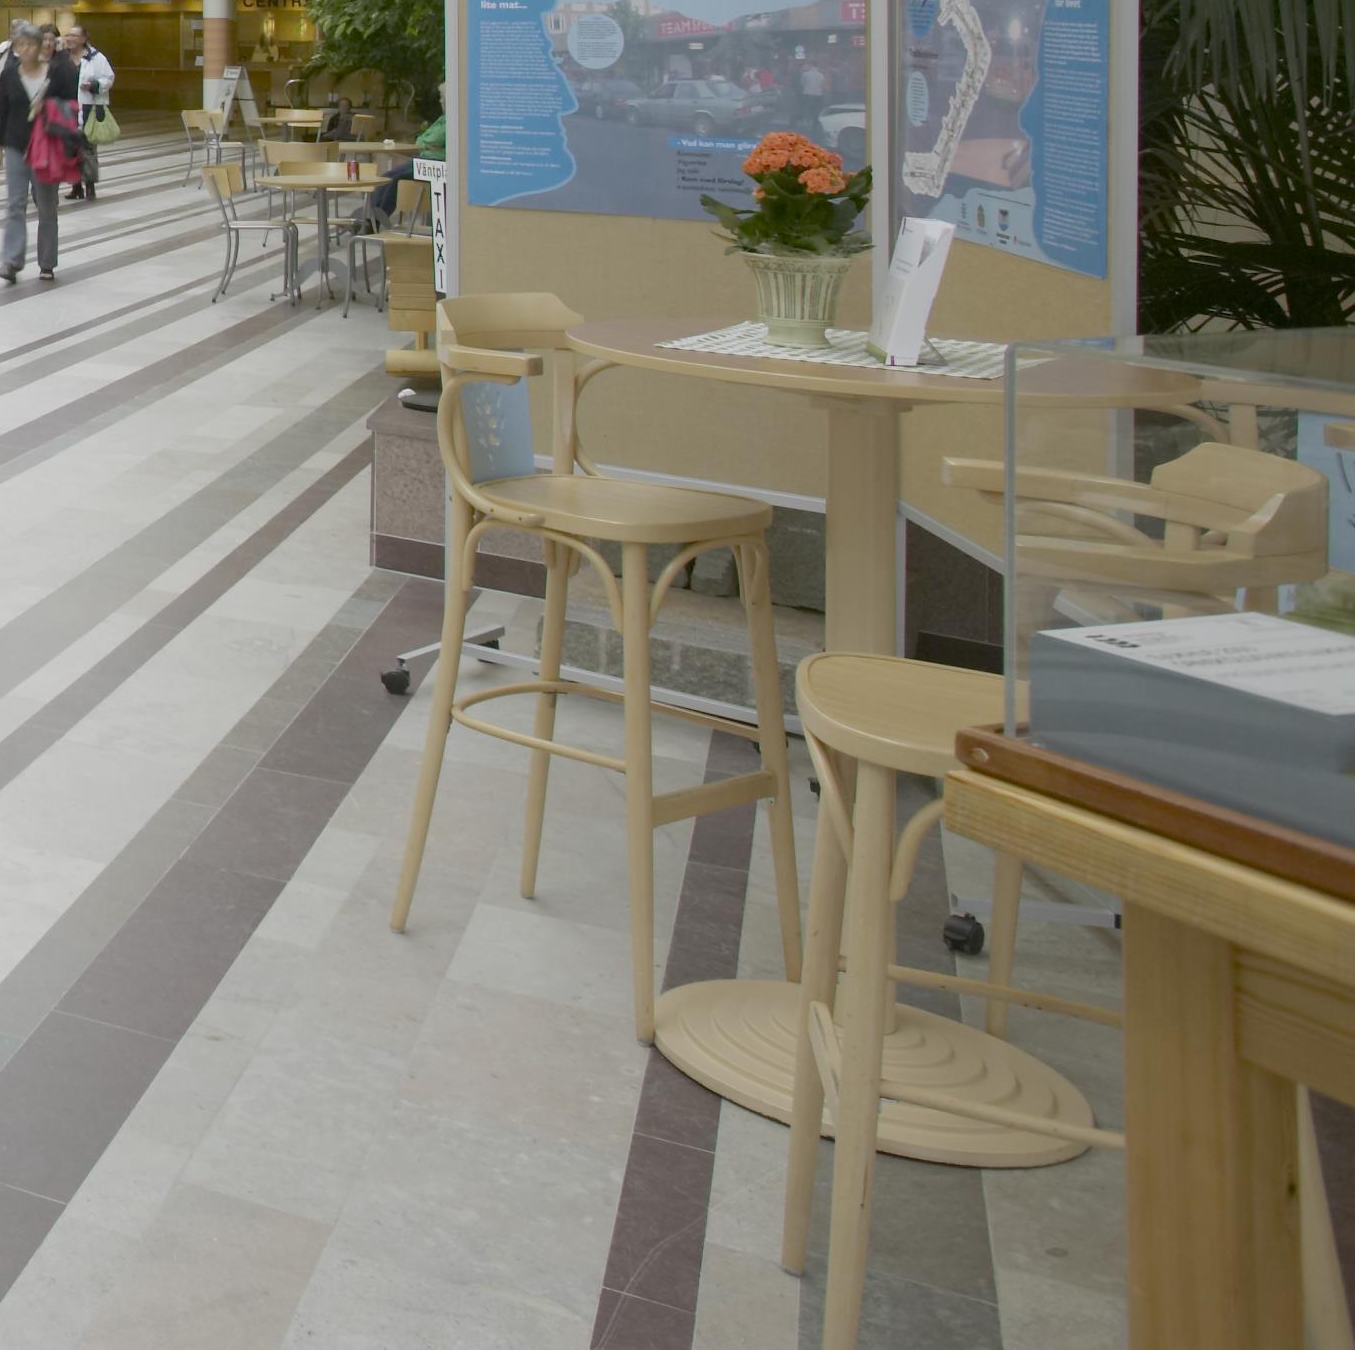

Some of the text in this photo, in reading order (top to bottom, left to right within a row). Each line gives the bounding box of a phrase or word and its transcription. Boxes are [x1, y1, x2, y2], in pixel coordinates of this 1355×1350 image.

[481, 0, 497, 9] lite
[416, 162, 447, 181] Väntpl
[434, 191, 446, 290] TAXI
